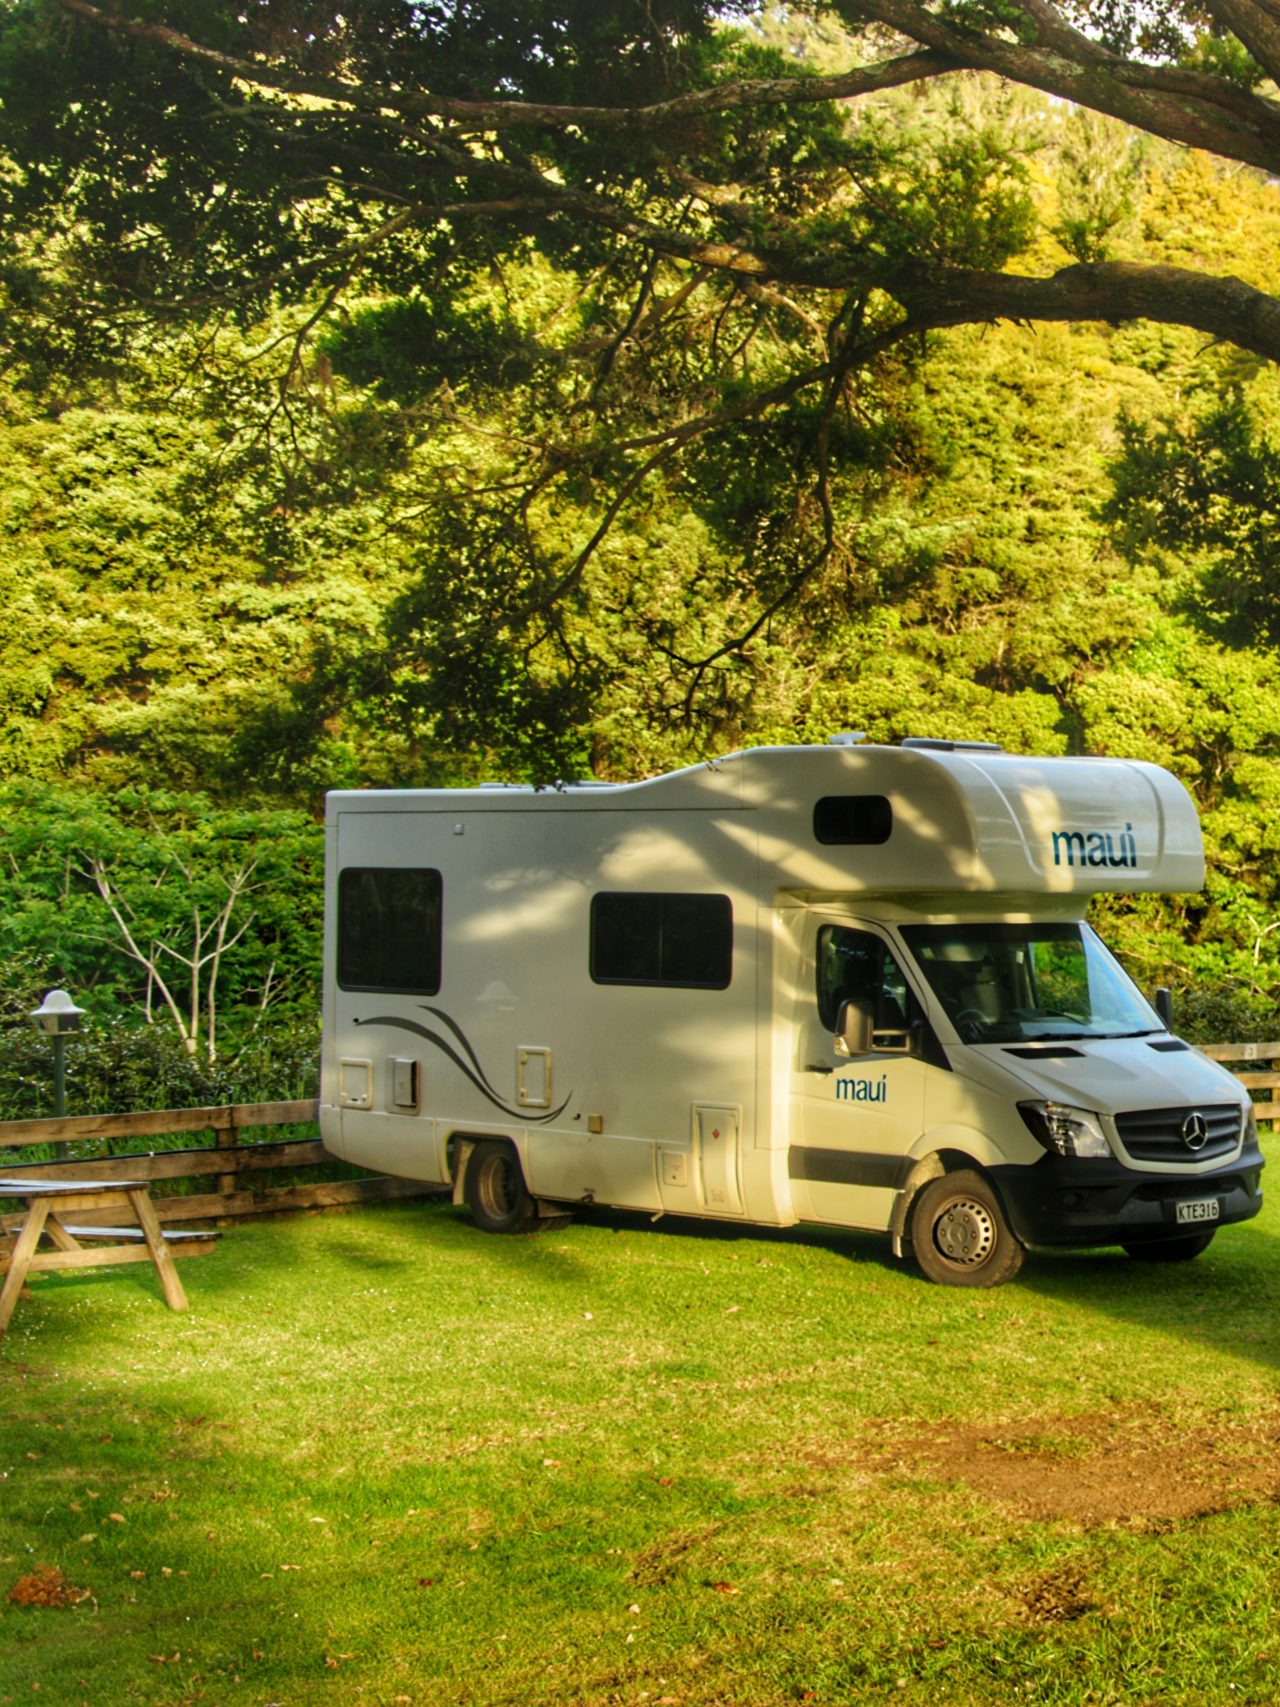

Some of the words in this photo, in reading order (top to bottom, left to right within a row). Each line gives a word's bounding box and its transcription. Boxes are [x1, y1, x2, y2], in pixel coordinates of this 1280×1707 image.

[1052, 822, 1137, 868] maui
[836, 1074, 887, 1103] maui
[1178, 1201, 1218, 1220] KTE316
